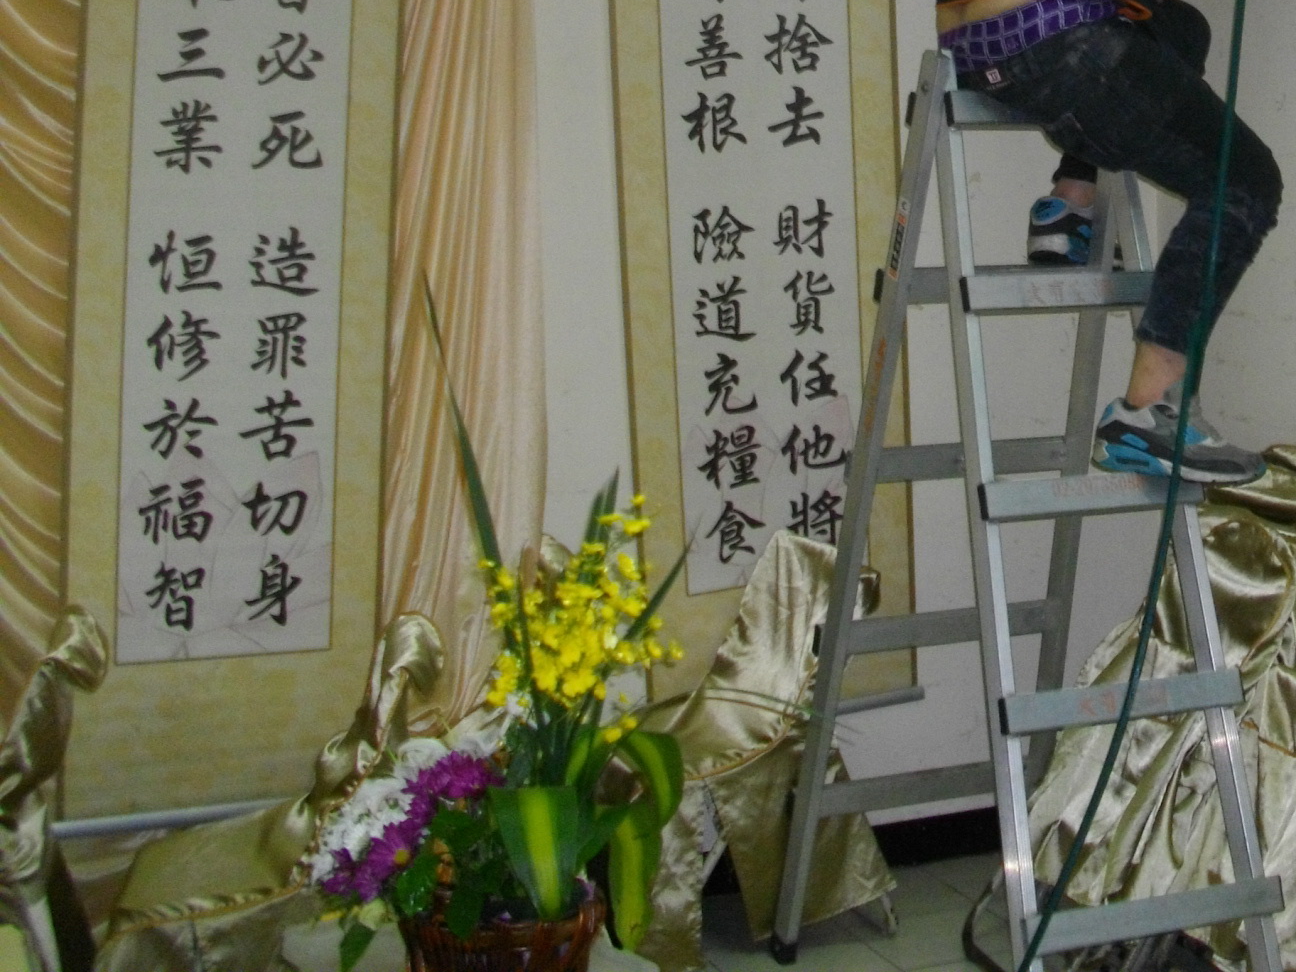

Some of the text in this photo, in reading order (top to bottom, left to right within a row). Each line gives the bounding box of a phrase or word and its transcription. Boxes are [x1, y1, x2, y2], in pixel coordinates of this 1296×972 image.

[239, 227, 320, 626] 造罪苦切身
[692, 205, 767, 564] 險道充糧食
[772, 199, 848, 545] 財貨任他將
